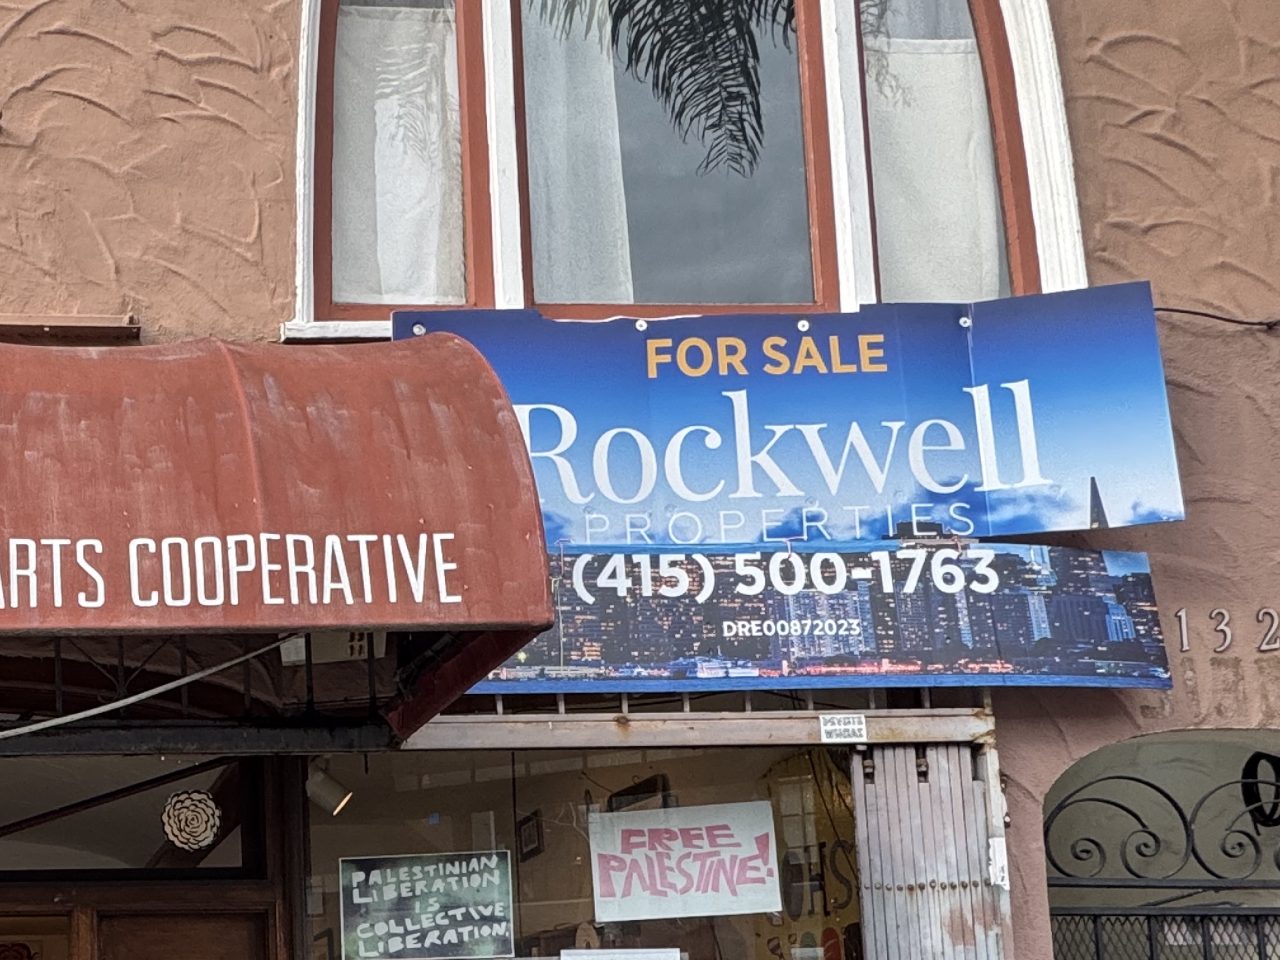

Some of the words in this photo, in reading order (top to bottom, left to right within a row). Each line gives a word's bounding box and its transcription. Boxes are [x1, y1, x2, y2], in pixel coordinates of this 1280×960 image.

[646, 337, 750, 378] FOR
[763, 334, 888, 375] SALE
[513, 379, 1053, 504] Rockwell
[585, 502, 976, 544] PROPERTIES
[129, 532, 462, 607] COOPERATIVE
[572, 552, 715, 604] (415)
[735, 549, 1000, 596] 500-1763
[722, 618, 861, 638] DRE00872023
[621, 824, 742, 854] FREE
[352, 854, 498, 887] PALESTINIAN
[597, 832, 774, 898] PALESTINE!
[352, 869, 500, 904] LIBERATION
[414, 897, 440, 913] IS
[356, 902, 505, 938] COLLECTIVE
